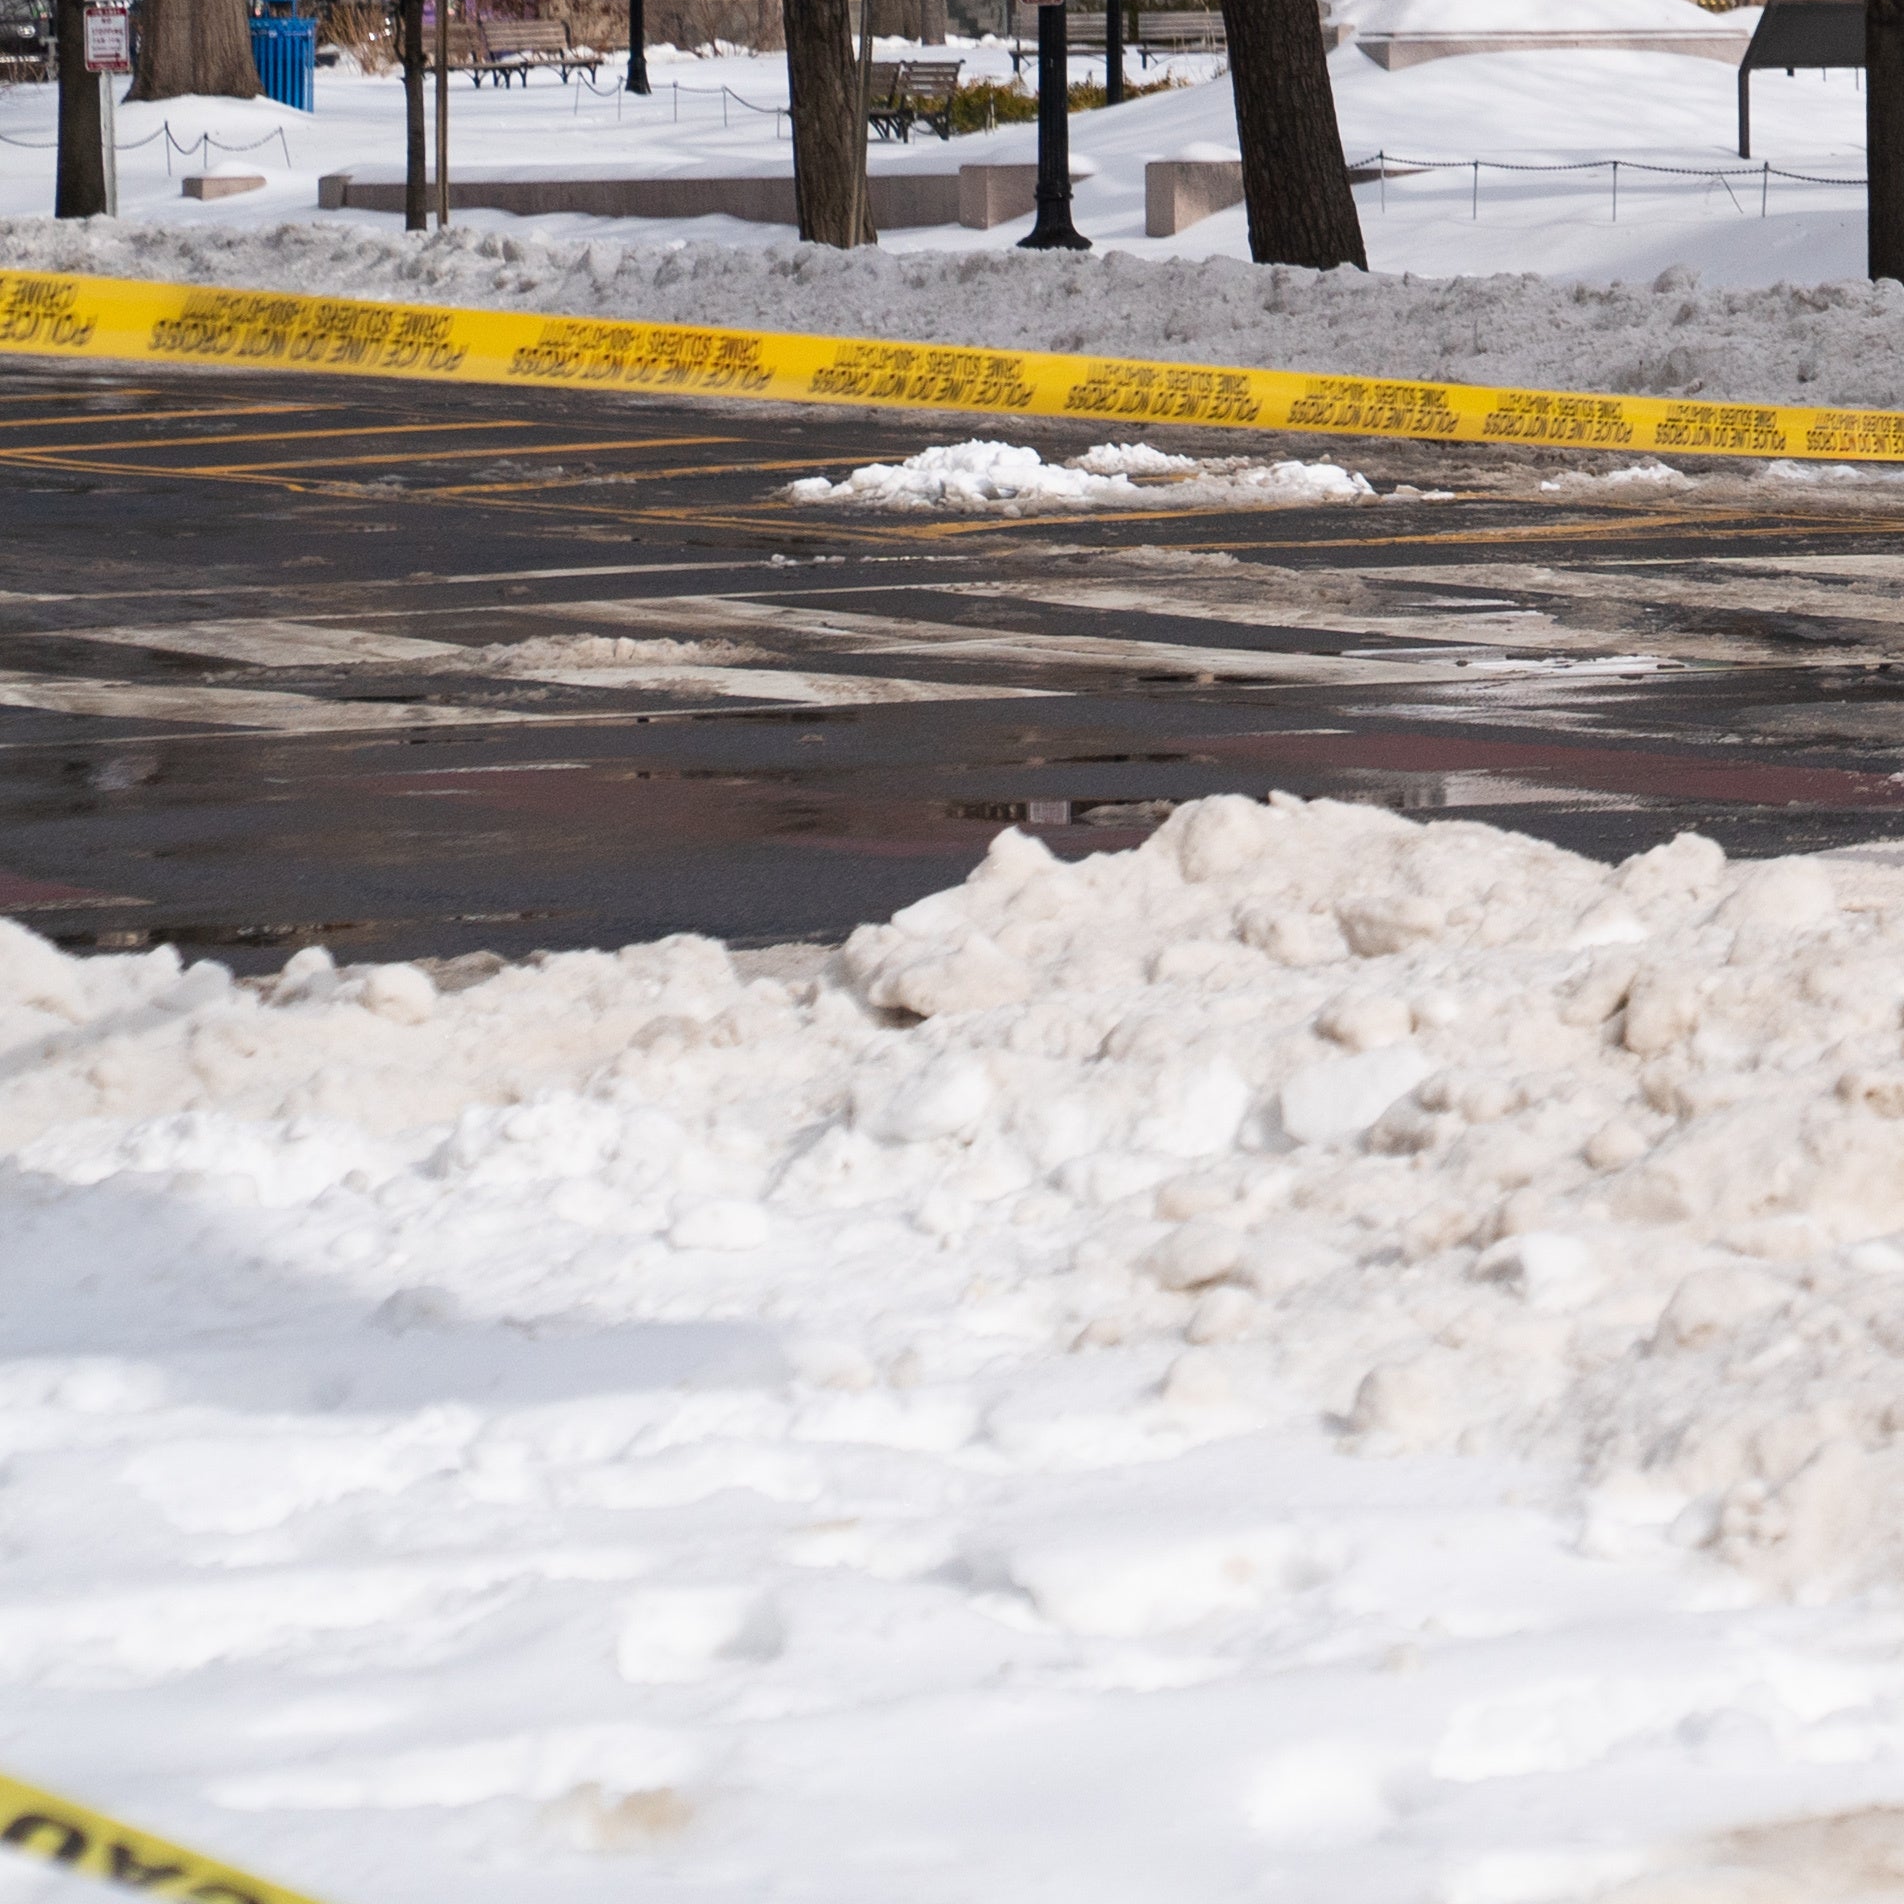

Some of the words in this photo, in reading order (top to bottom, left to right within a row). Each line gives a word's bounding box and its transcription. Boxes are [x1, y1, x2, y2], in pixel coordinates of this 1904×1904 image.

[1654, 423, 1690, 445] CROSS
[1690, 425, 1712, 446] NOT
[1713, 426, 1729, 447] DO
[1730, 427, 1752, 448] LINE
[1752, 429, 1786, 450] POLICE
